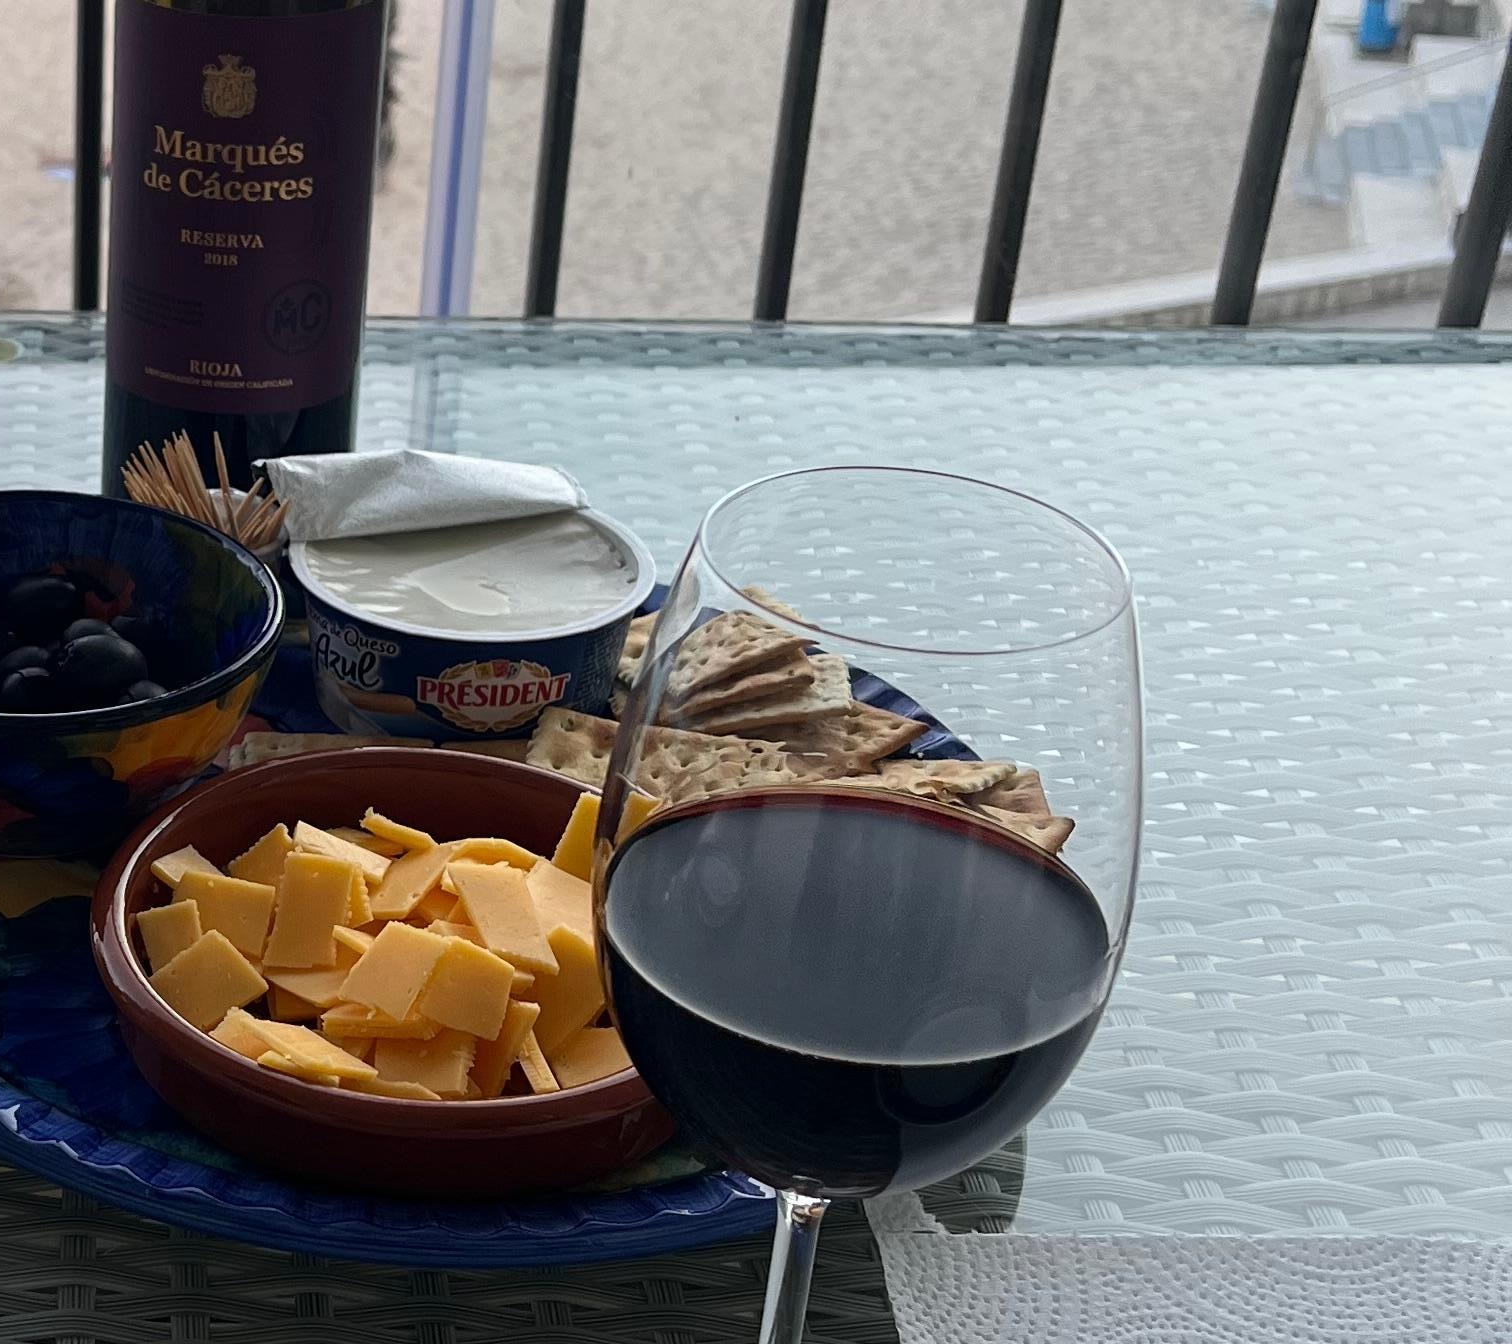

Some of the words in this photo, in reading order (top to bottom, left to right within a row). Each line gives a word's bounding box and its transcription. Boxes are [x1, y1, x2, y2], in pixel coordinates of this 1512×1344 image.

[153, 124, 305, 174] Marqués
[143, 162, 172, 192] de
[178, 168, 314, 203] Cáceres
[180, 228, 265, 249] RESERVA
[203, 252, 239, 267] 2018
[189, 359, 242, 377] RIOJA
[344, 626, 397, 653] Queso
[315, 633, 381, 688] Azul
[419, 675, 567, 711] PRÉSIDENT
